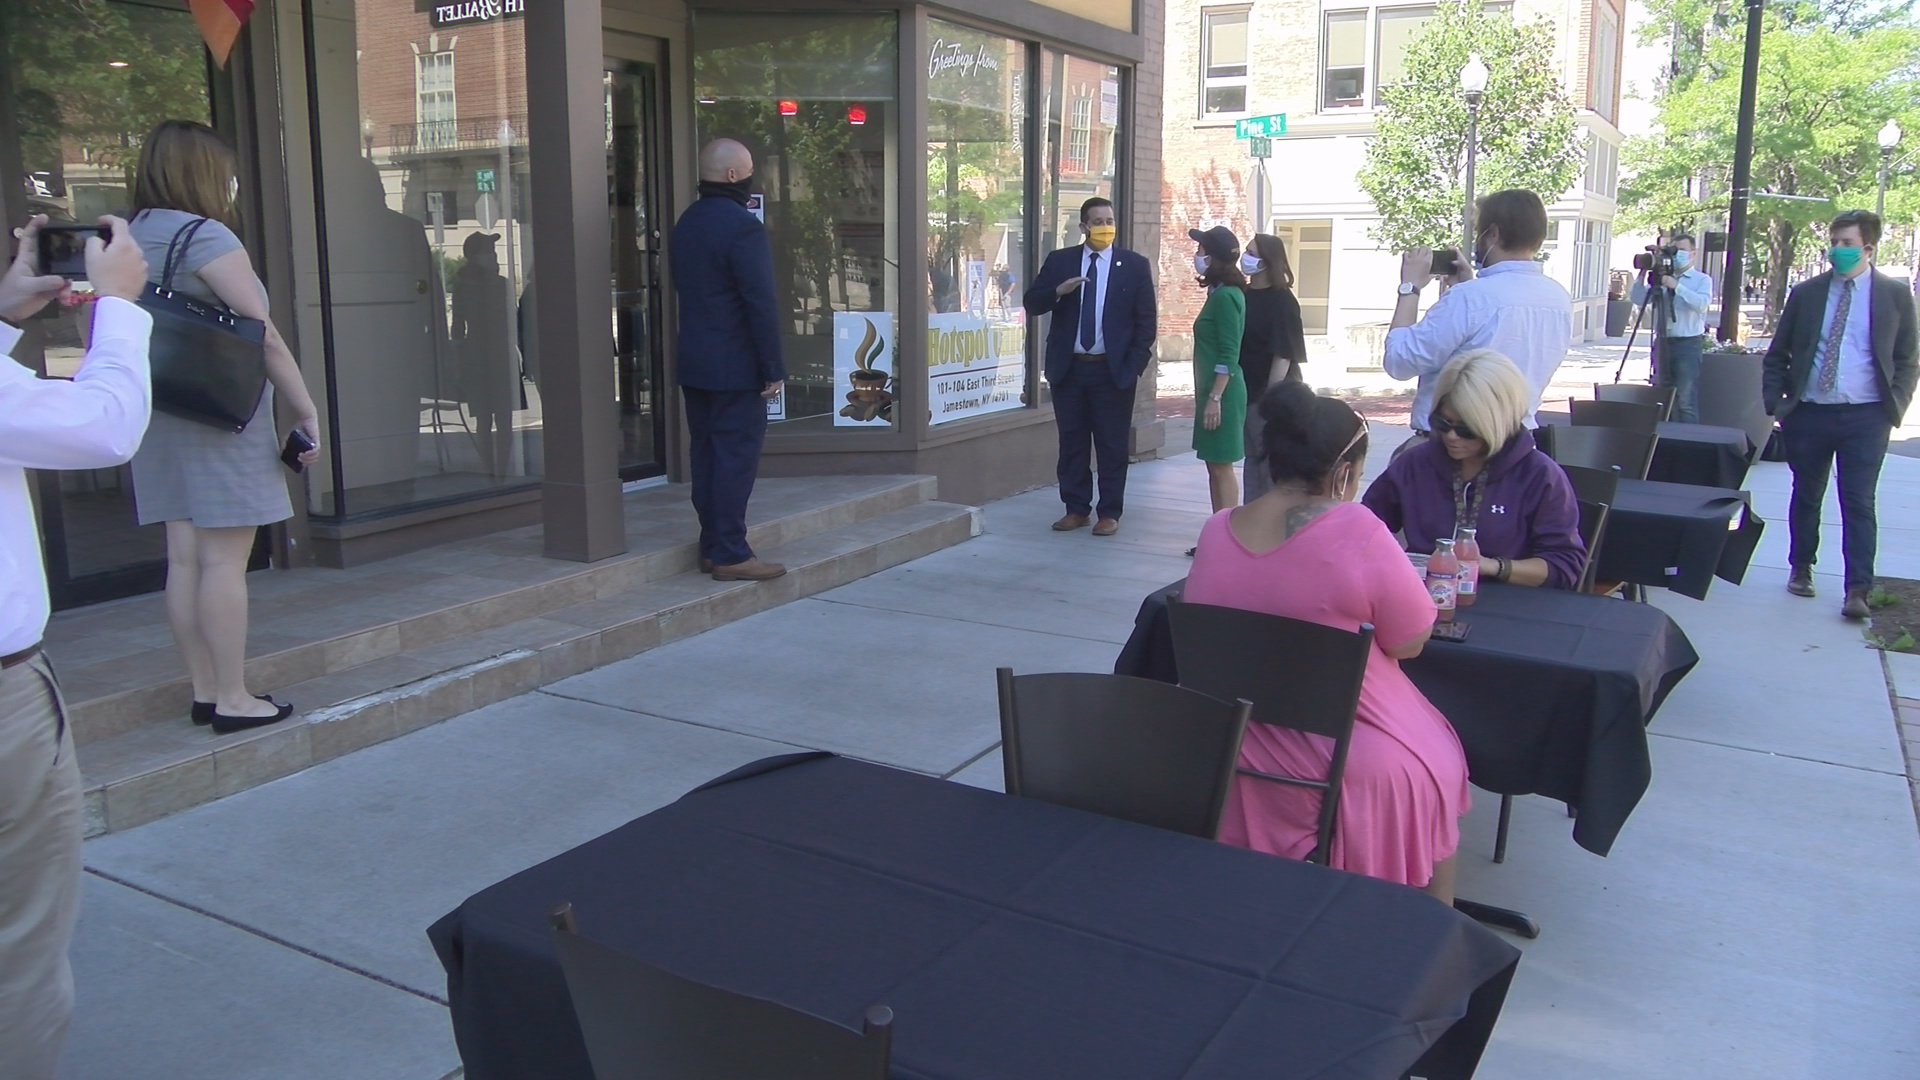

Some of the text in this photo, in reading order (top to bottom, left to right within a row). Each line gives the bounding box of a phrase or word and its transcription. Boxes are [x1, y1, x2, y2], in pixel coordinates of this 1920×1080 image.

[973, 44, 998, 77] from
[1240, 115, 1282, 137] Pine St
[928, 324, 989, 367] Hotspot
[938, 380, 965, 395] 101-104
[966, 378, 980, 391] East
[981, 375, 996, 388] Third
[943, 397, 980, 413] Jamestown,
[981, 394, 990, 405] NY
